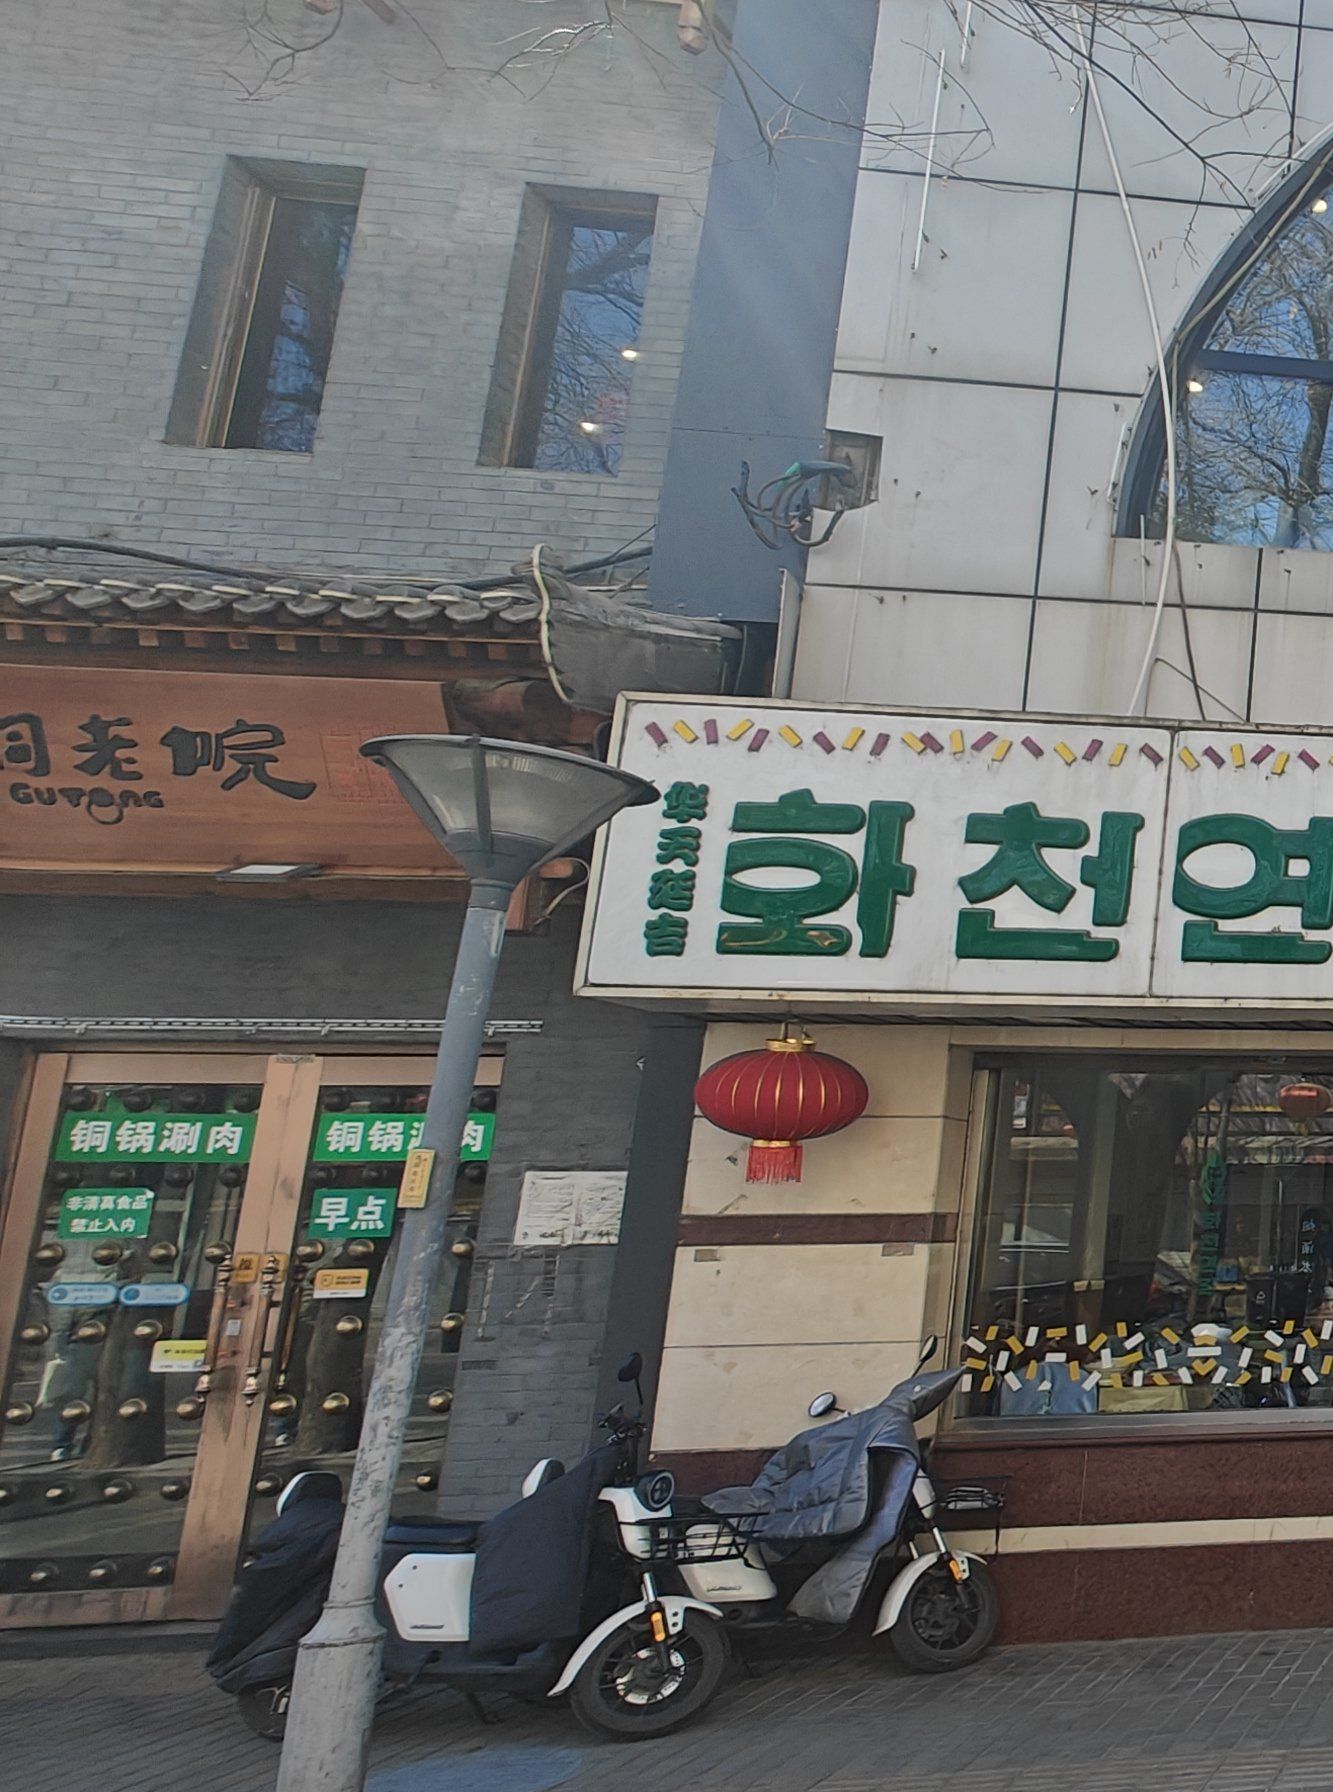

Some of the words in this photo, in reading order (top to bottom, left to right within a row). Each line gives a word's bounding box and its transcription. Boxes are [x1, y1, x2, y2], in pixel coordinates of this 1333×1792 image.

[644, 781, 709, 957] 华天延吉
[69, 1120, 244, 1155] 铜锅涮肉
[326, 1120, 485, 1155] 铜锅肉
[66, 1195, 148, 1211] 非清真食品
[315, 1195, 387, 1231] 早点
[70, 1217, 137, 1233] 禁止入内
